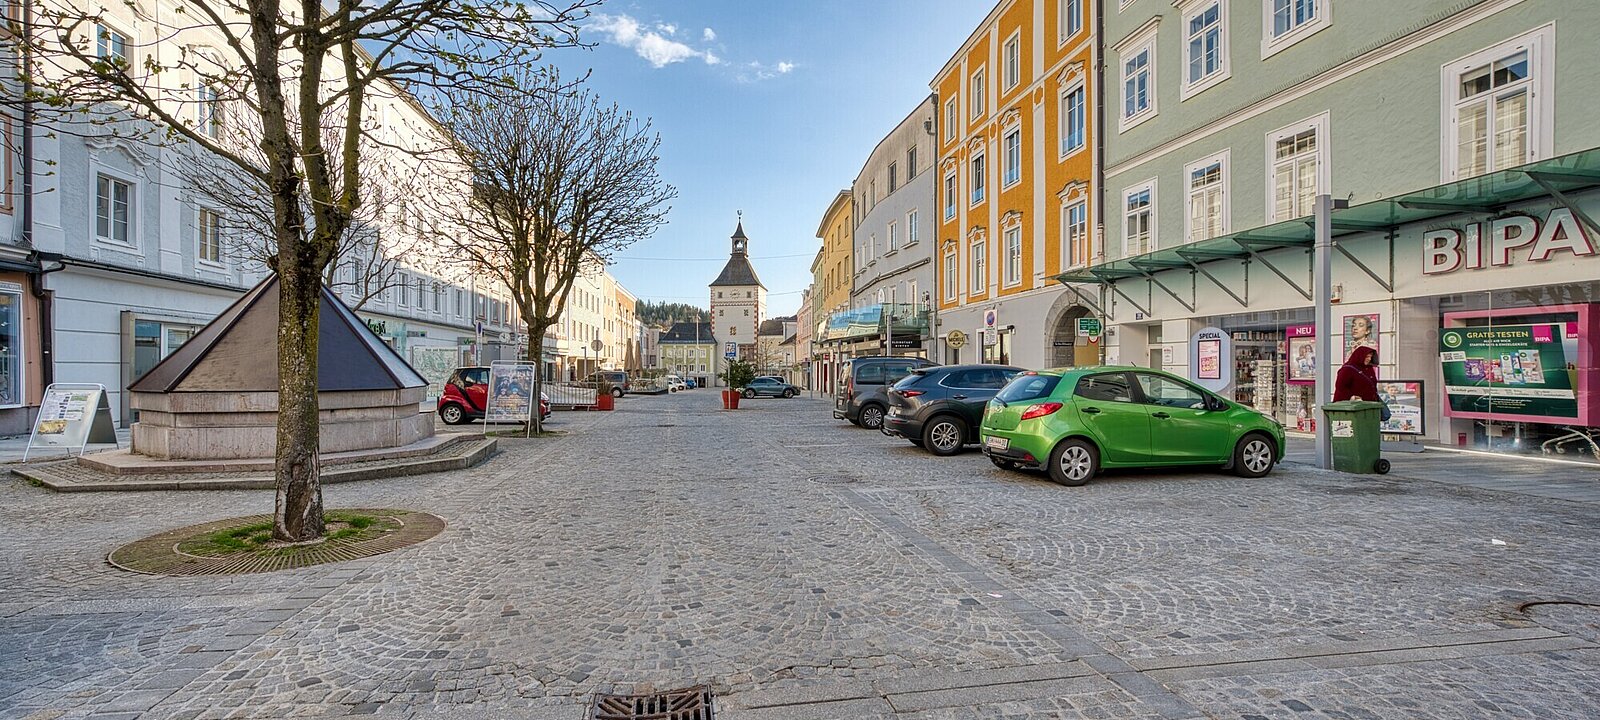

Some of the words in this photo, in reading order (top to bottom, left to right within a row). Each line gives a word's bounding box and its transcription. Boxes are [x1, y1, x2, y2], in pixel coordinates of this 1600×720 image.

[1422, 207, 1595, 275] BIPA
[1295, 326, 1311, 335] NEU
[1466, 331, 1495, 339] GRATIS
[1496, 330, 1529, 338] TESTEN
